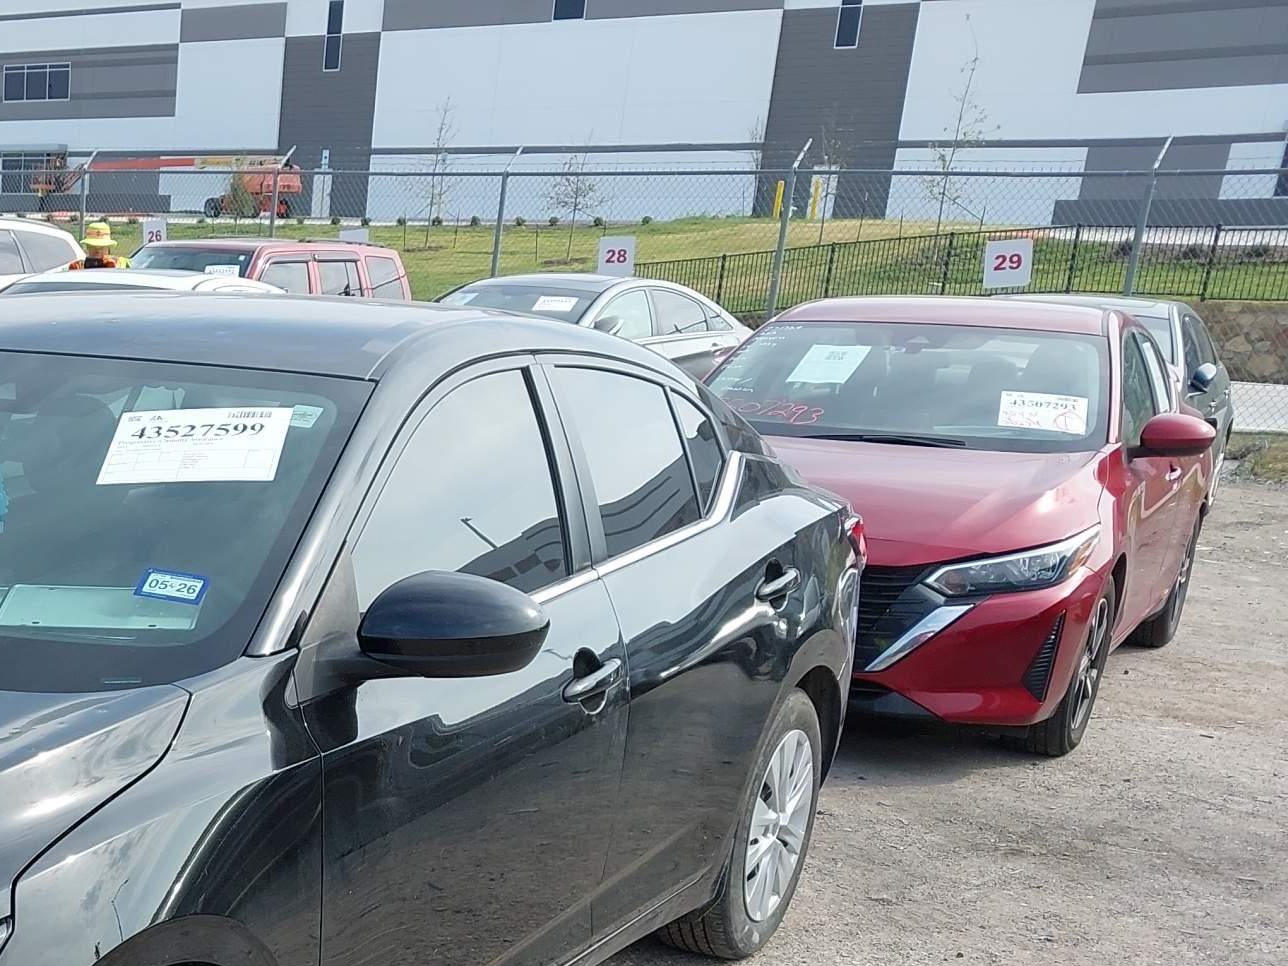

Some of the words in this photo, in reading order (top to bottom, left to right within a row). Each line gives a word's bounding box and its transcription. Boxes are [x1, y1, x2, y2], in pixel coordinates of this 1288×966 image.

[148, 230, 162, 242] 26
[605, 249, 628, 263] 28
[993, 253, 1023, 271] 29
[131, 422, 266, 440] 43527599
[148, 579, 169, 590] 05
[176, 583, 198, 595] 26
